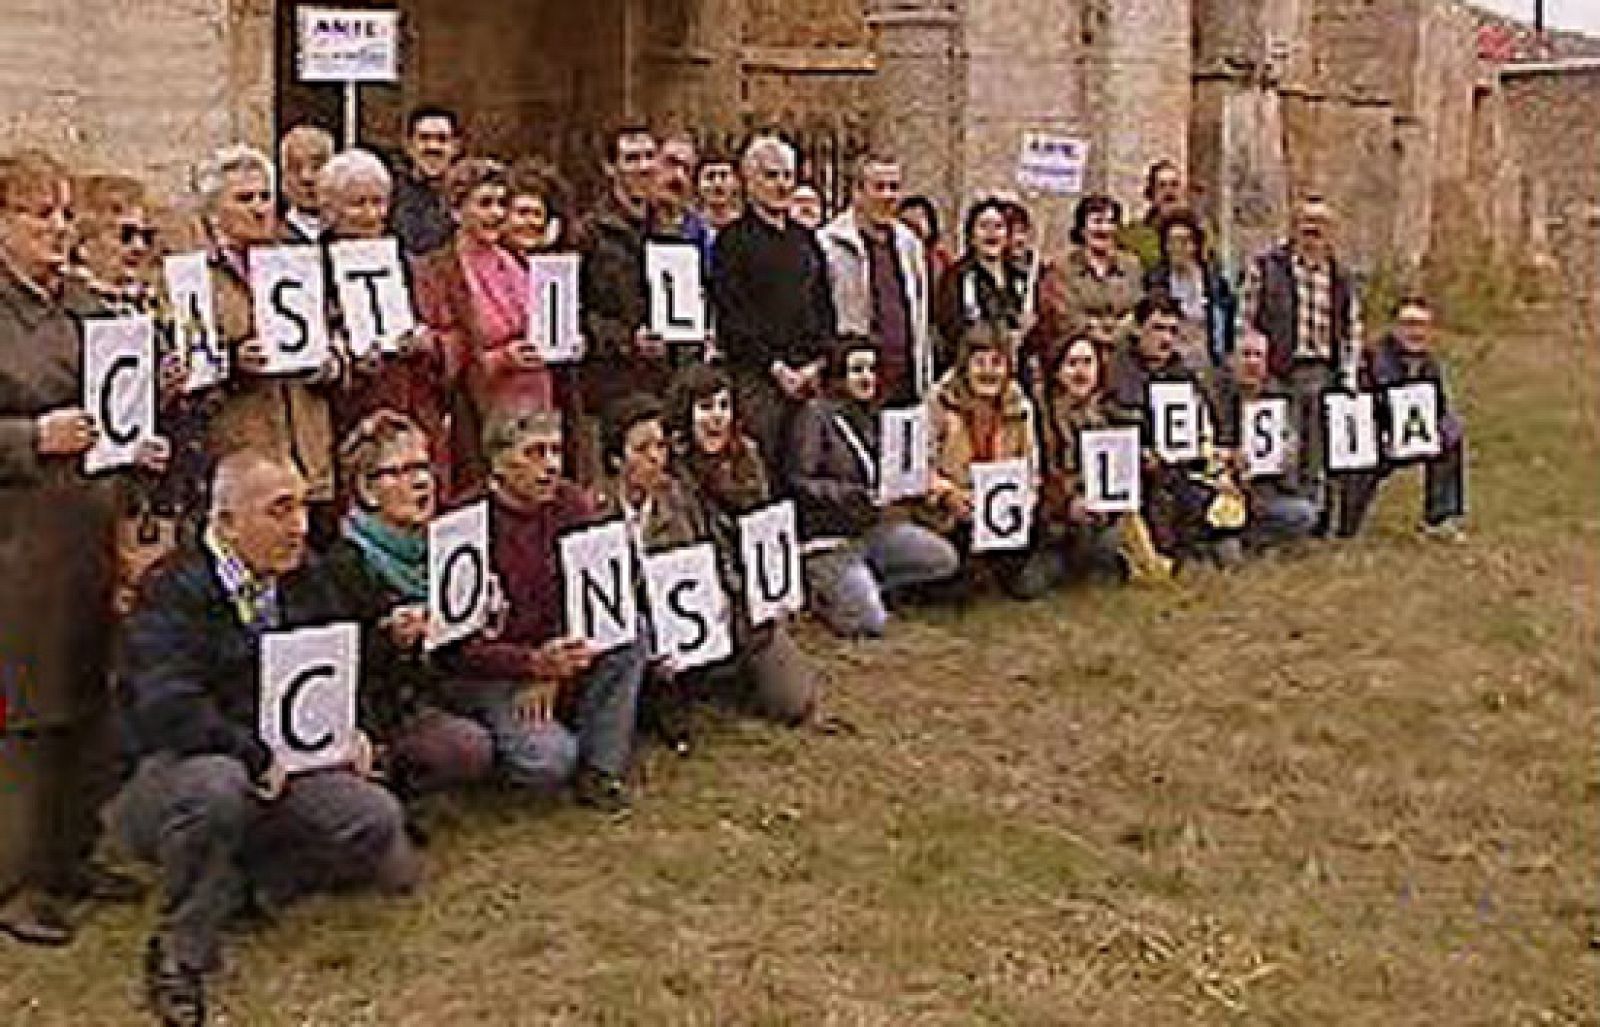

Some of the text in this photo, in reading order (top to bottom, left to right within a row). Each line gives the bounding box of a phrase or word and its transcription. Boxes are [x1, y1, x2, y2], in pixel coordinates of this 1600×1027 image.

[270, 278, 309, 353] S
[345, 269, 390, 335] T
[548, 281, 560, 347] I
[660, 269, 694, 327] L
[100, 355, 139, 443] C
[1168, 402, 1190, 448] E
[1402, 405, 1433, 443] A
[1253, 408, 1273, 457] S
[983, 481, 1024, 536] G
[1097, 451, 1130, 501] L
[439, 545, 484, 622] O
[582, 558, 629, 640] N
[755, 533, 790, 604] U
[668, 580, 710, 653] S
[280, 665, 335, 752] C
